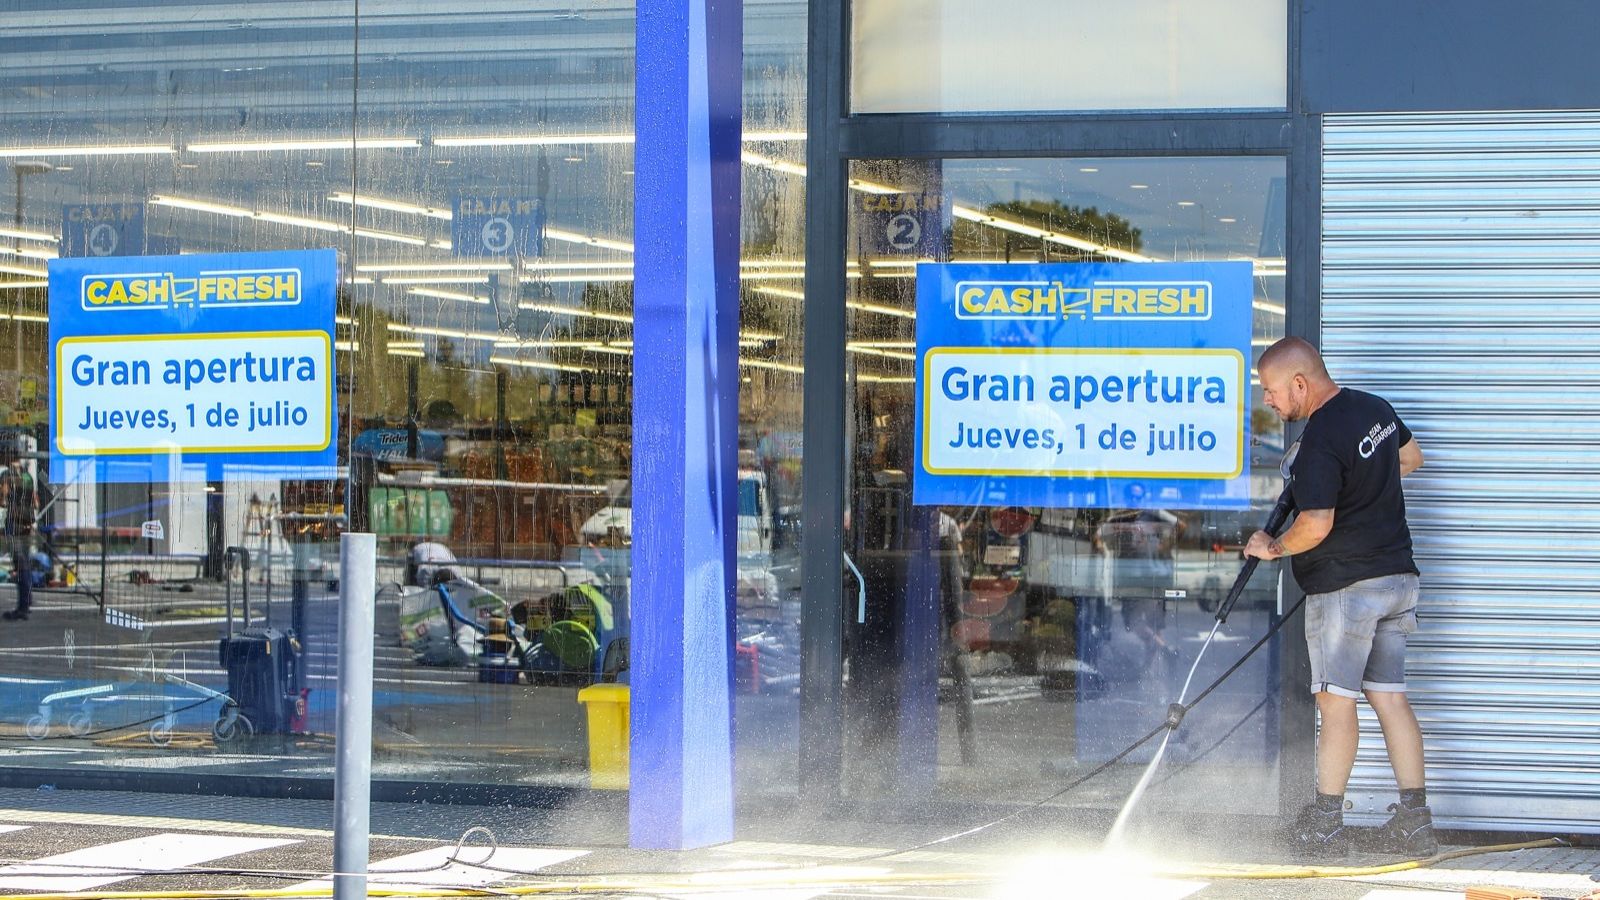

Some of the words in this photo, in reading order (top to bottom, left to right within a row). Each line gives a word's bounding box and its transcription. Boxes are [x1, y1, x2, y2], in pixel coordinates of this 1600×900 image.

[460, 200, 512, 215] CAJA
[863, 195, 918, 212] CAJA
[487, 222, 508, 247] 3
[893, 218, 915, 245] 2
[87, 279, 169, 305] CASH
[199, 275, 295, 300] FRESH
[962, 287, 1056, 313] CASH
[1092, 288, 1205, 313] FRESH
[71, 354, 151, 387] Gran
[162, 351, 316, 391] apertura
[942, 366, 1035, 403] Gran
[1049, 369, 1226, 410] apertura
[79, 405, 177, 433] Jueves,
[185, 403, 195, 428] 1
[205, 402, 240, 428] de
[247, 400, 308, 432] julio
[948, 422, 1064, 455] Jueves,
[1075, 423, 1085, 449] 1
[1099, 422, 1137, 450] de
[1146, 423, 1217, 456] julio
